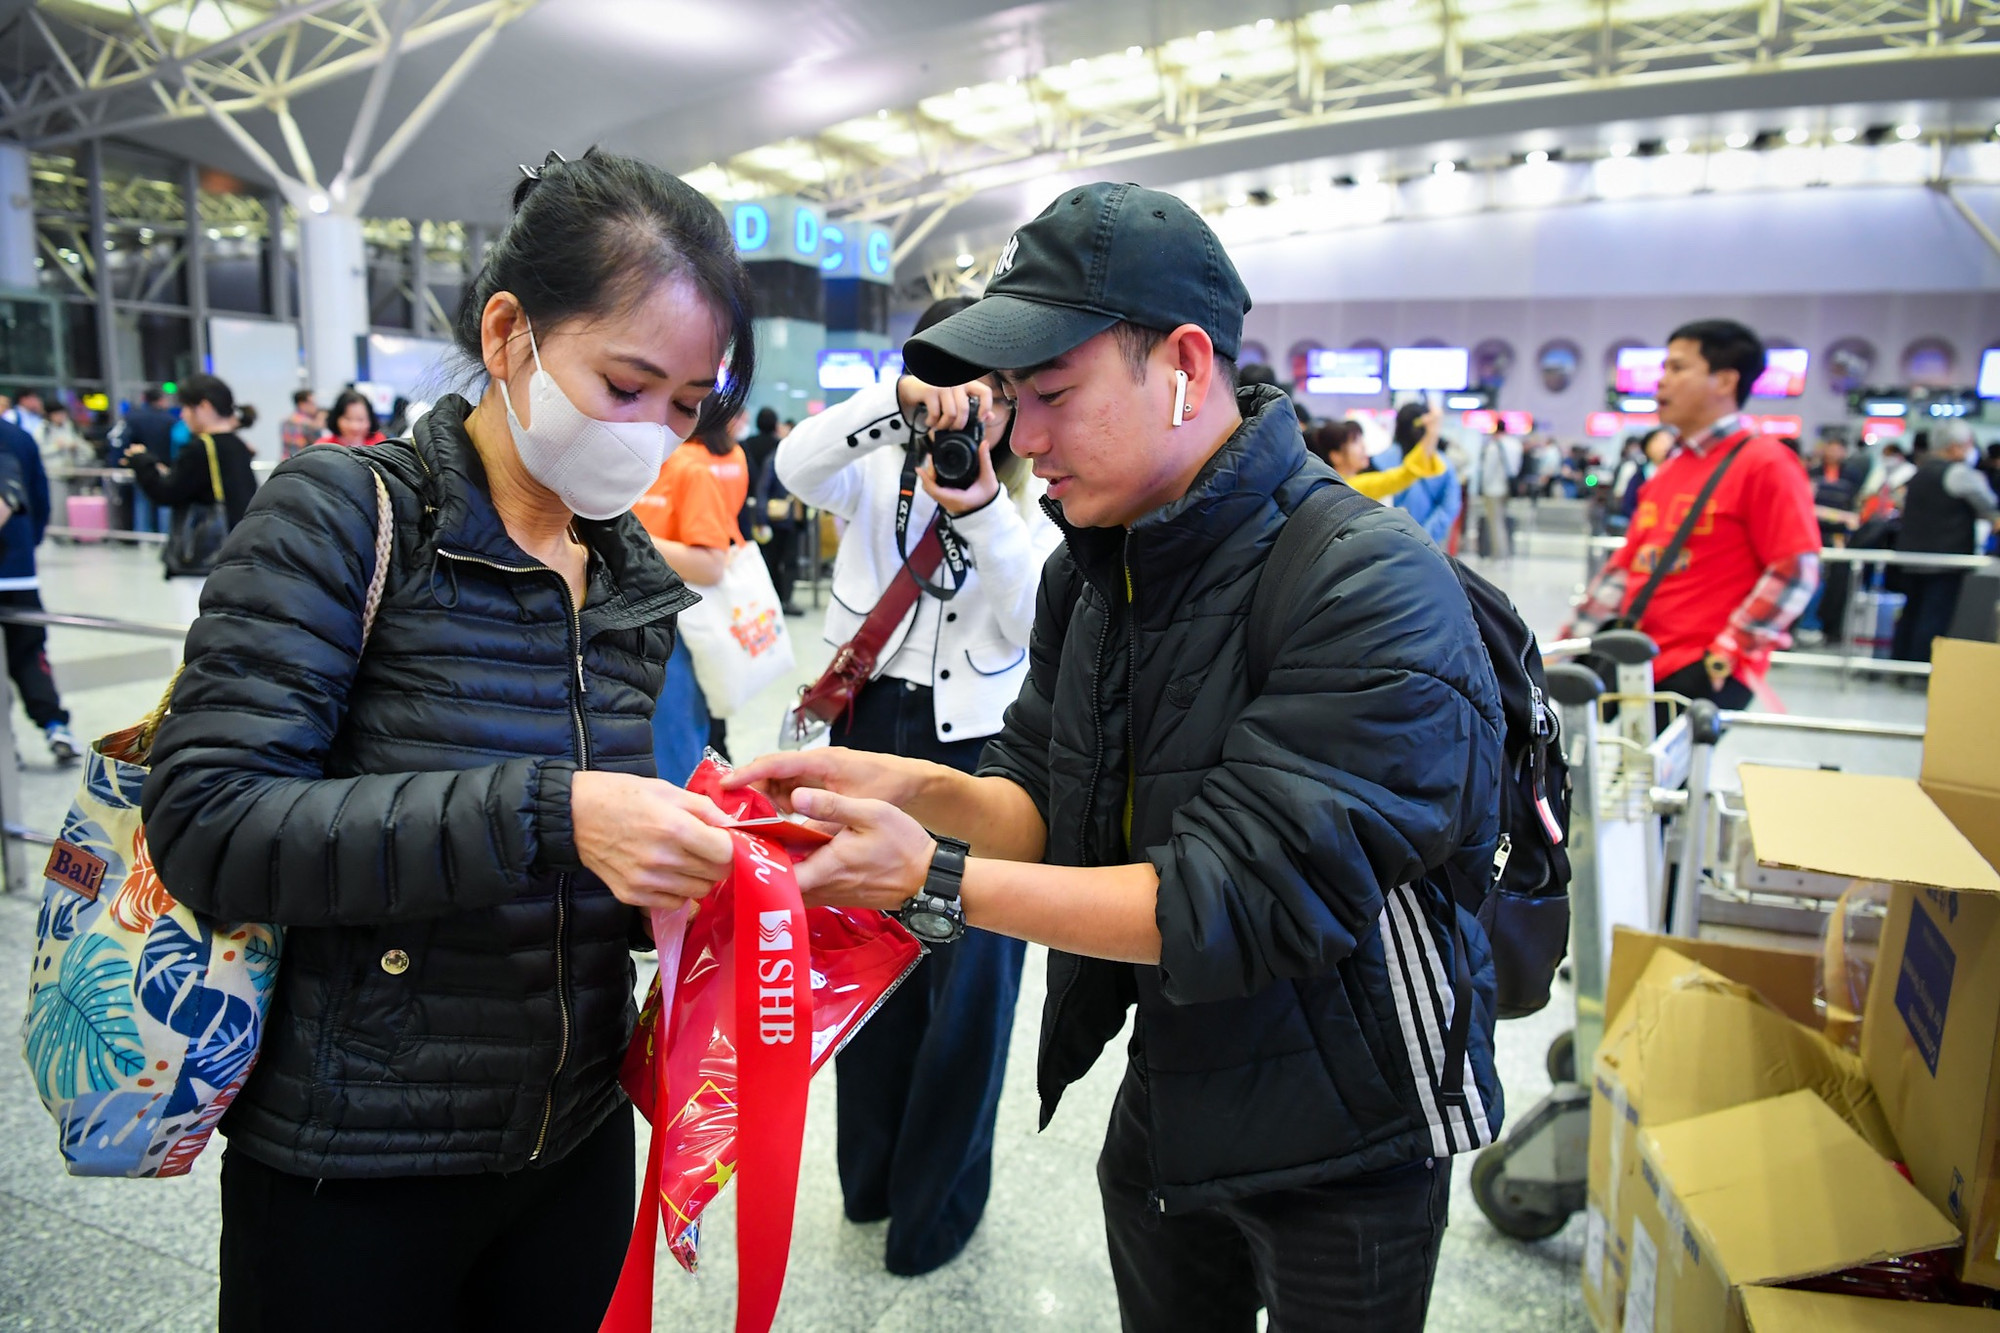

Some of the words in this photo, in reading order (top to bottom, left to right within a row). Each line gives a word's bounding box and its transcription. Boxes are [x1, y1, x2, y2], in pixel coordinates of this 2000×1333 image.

[734, 203, 768, 251] D
[795, 207, 818, 254] D
[868, 231, 889, 274] C
[938, 528, 964, 572] SONY
[53, 849, 98, 890] Bali
[758, 959, 794, 1045] SHB
